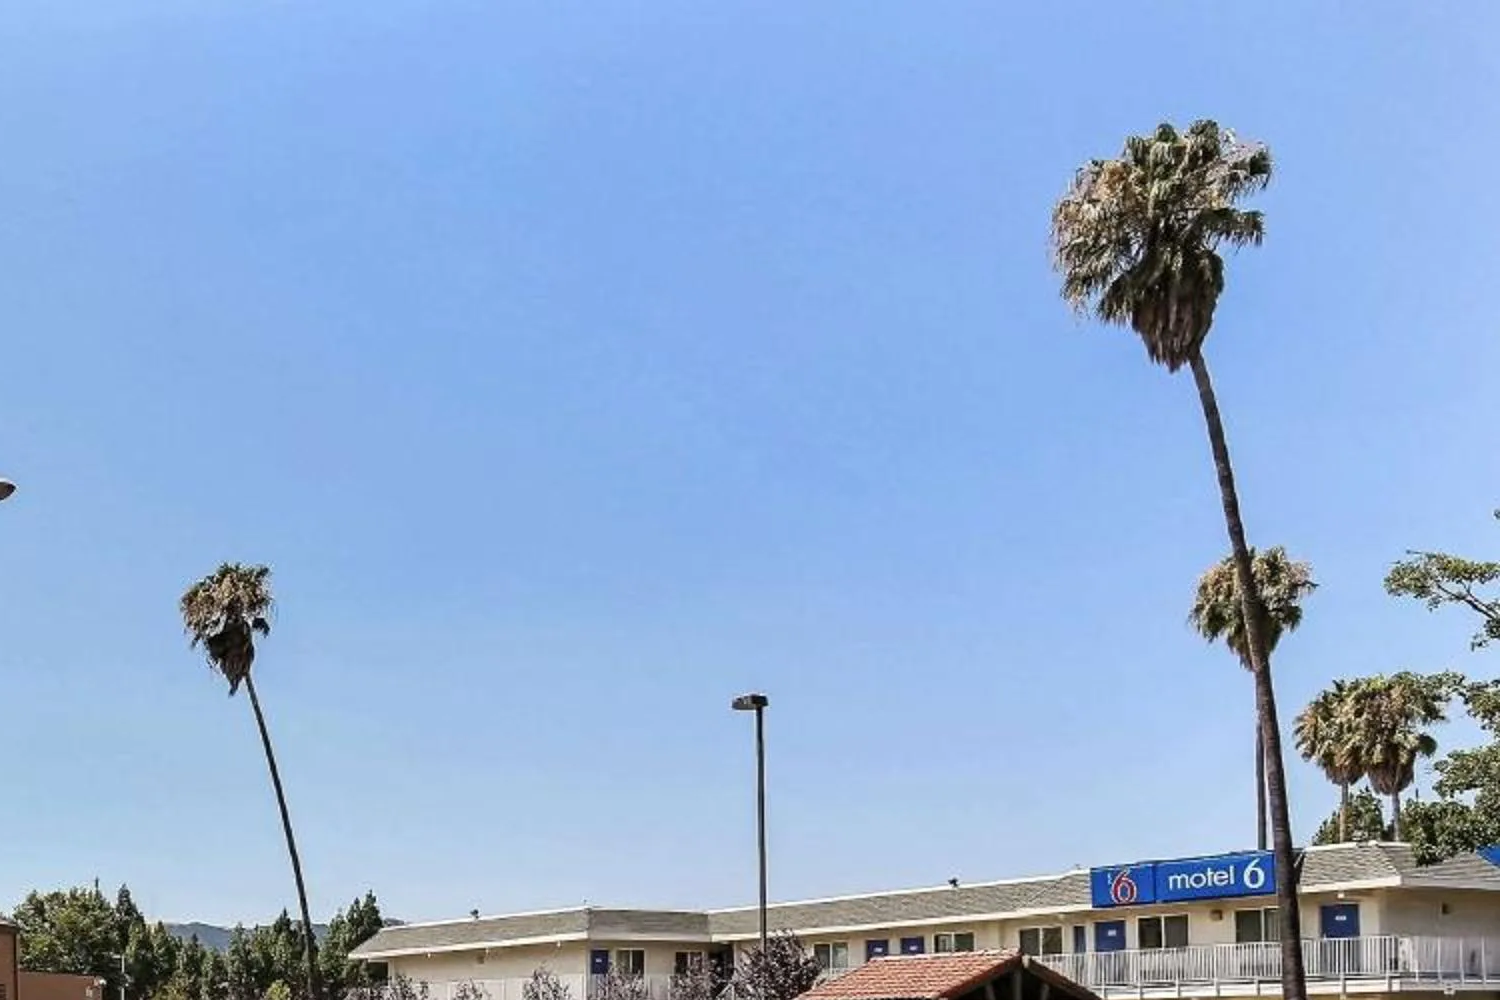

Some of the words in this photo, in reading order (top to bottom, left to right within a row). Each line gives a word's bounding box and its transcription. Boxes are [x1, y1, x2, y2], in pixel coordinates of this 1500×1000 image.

[1111, 868, 1138, 904] 6
[1168, 865, 1235, 891] motel
[1243, 856, 1266, 890] 6
